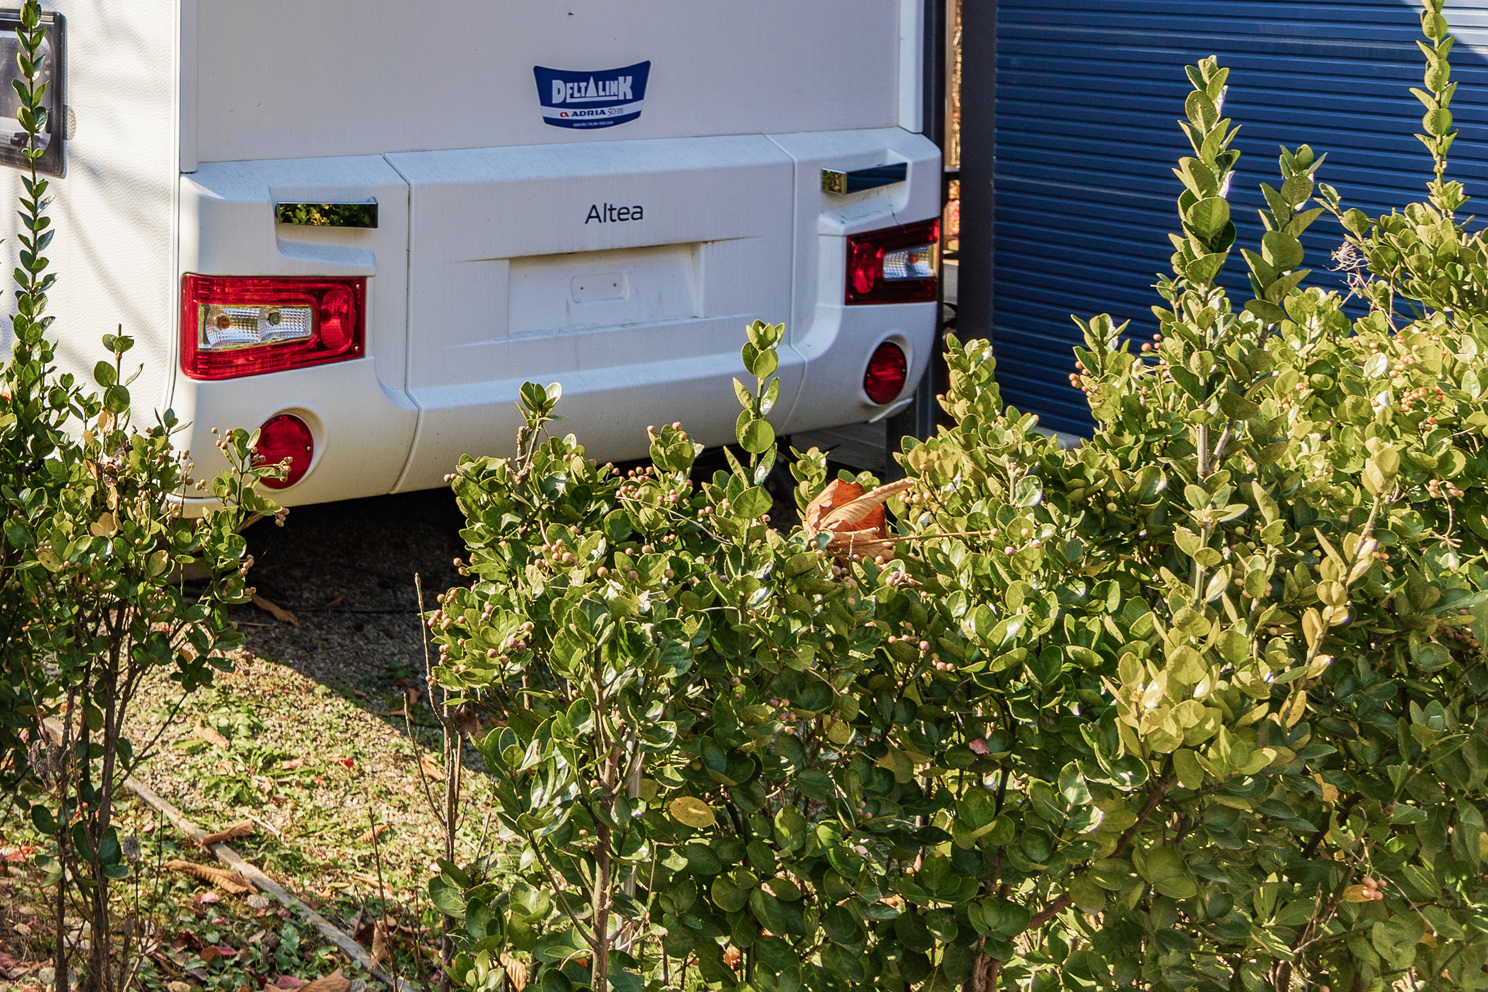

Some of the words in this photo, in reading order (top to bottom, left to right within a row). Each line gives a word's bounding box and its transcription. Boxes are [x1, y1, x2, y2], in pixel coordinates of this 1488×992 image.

[551, 75, 633, 104] DELTALINK
[571, 109, 606, 117] ADRIA
[584, 202, 644, 224] Altea
